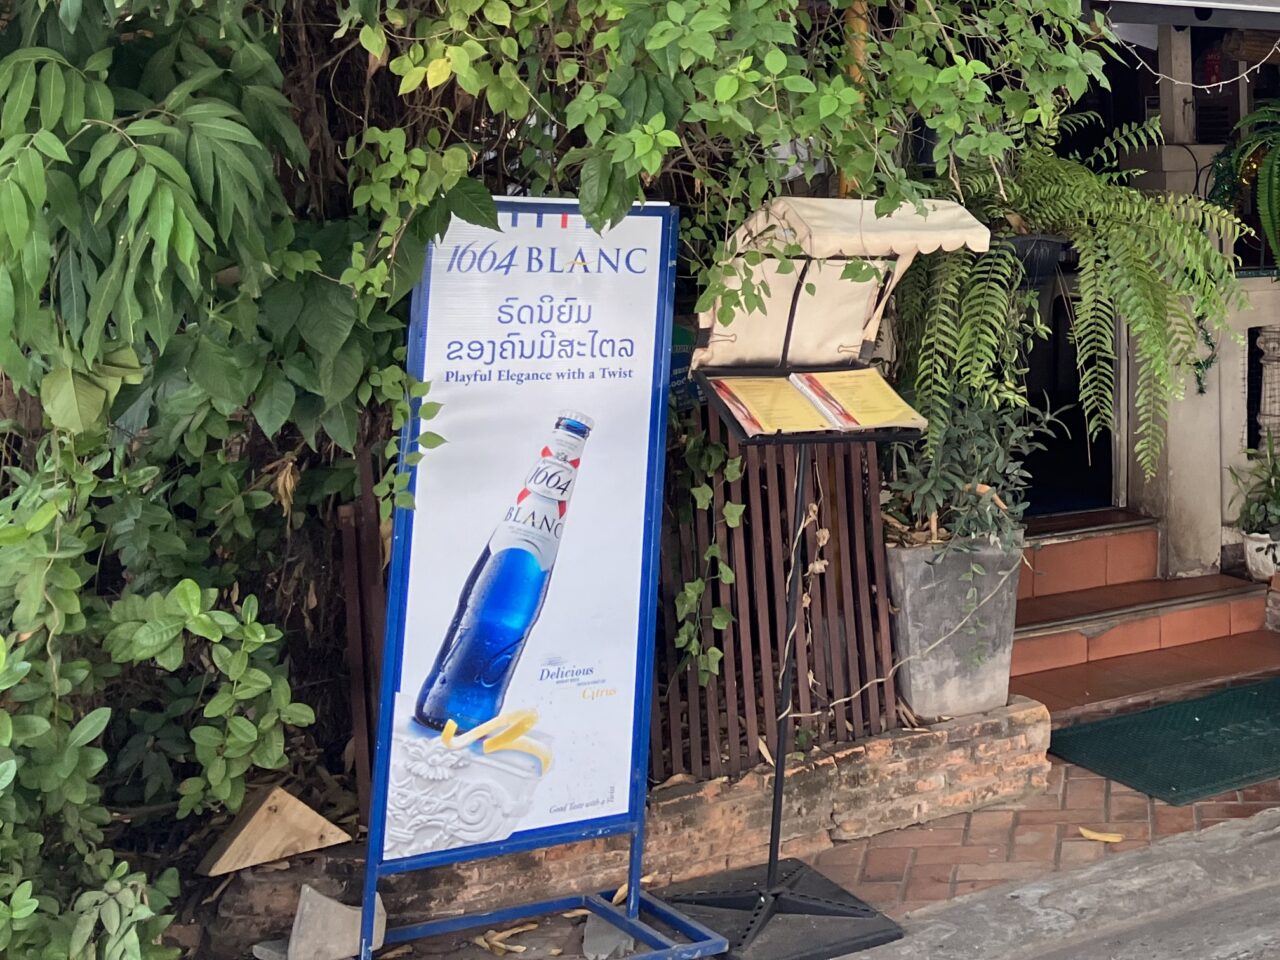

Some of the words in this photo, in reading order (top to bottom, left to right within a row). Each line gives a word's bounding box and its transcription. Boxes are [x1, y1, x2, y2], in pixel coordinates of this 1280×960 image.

[447, 240, 519, 276] 1664
[526, 246, 648, 274] BLANC
[445, 370, 492, 386] Playful
[497, 369, 552, 385] Elegance
[556, 368, 585, 380] with
[588, 371, 595, 379] a
[599, 367, 633, 379] Twist
[528, 464, 573, 496] 1664
[504, 506, 563, 539] BLANC
[540, 665, 594, 681] Delicious
